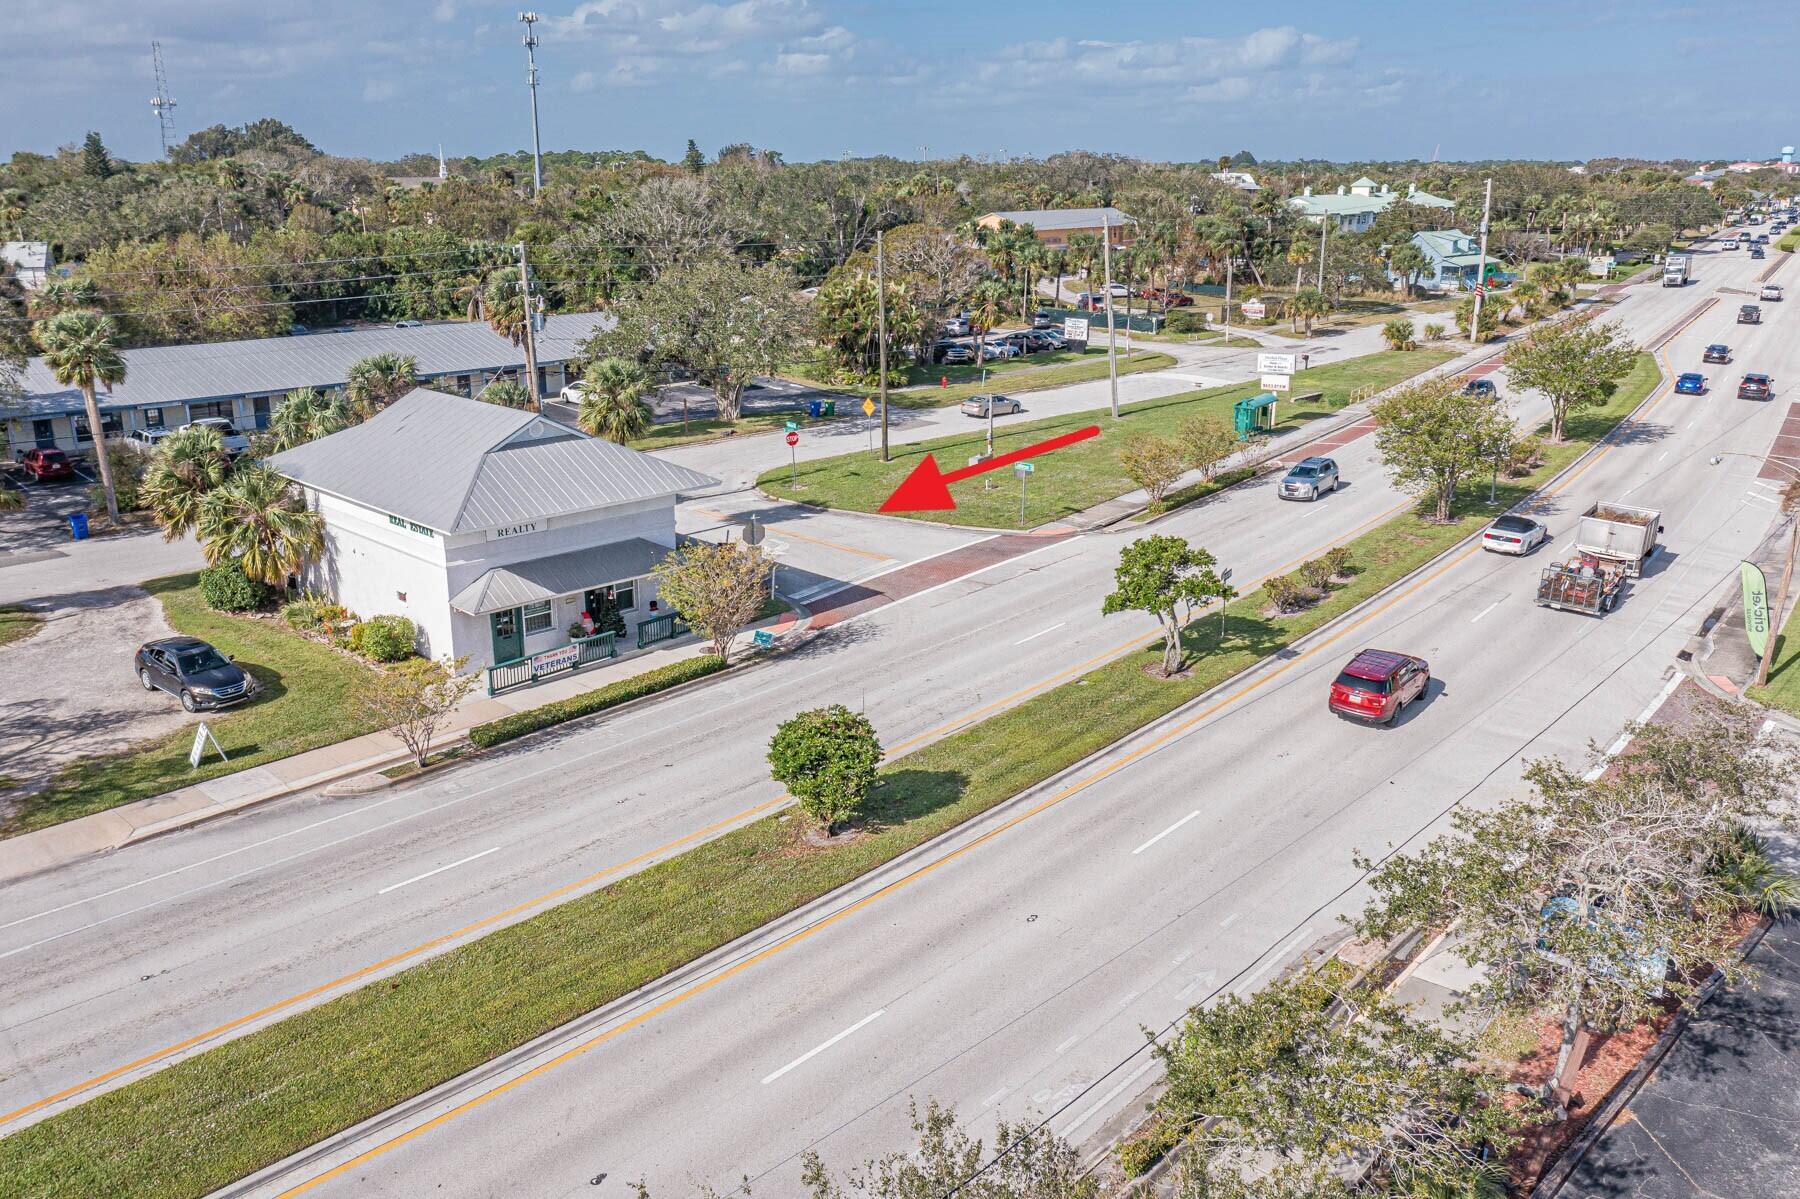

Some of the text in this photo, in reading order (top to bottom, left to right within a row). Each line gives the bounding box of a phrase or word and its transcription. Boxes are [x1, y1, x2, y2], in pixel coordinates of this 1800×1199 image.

[389, 514, 435, 539] REAL ESTATE
[497, 522, 537, 538] REALTY
[533, 654, 578, 672] VETERANS
[544, 652, 558, 660] THANK
